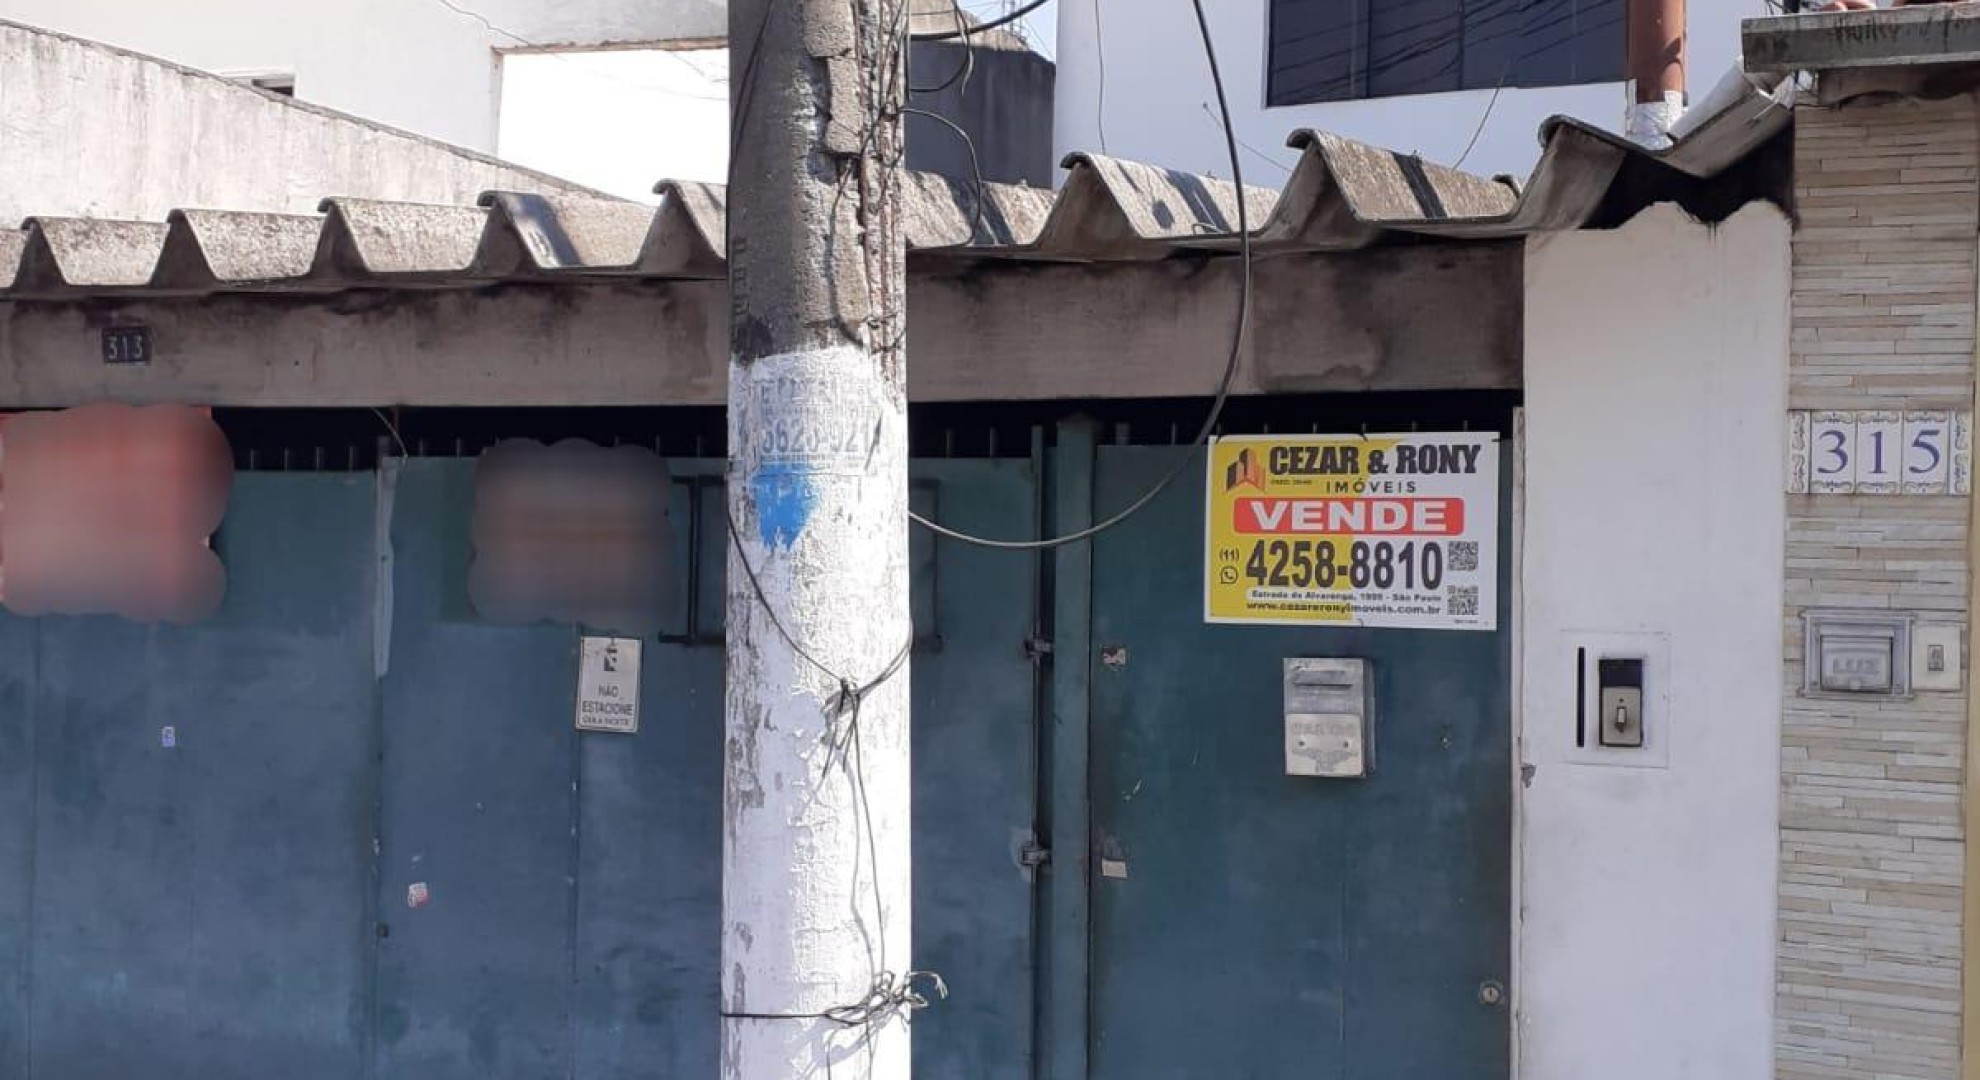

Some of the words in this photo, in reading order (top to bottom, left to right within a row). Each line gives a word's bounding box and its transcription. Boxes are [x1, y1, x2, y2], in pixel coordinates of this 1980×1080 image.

[108, 335, 143, 360] 313
[1269, 446, 1359, 475] CEZAR
[1368, 449, 1389, 474] &
[1396, 444, 1482, 474] RONY
[1817, 429, 1941, 474] 315
[1326, 477, 1417, 494] IMÓVEIS
[1250, 501, 1448, 532] VENDE
[1219, 548, 1240, 562] (11)
[1246, 539, 1443, 590] 4258-8810
[582, 700, 634, 716] ESTACIONE
